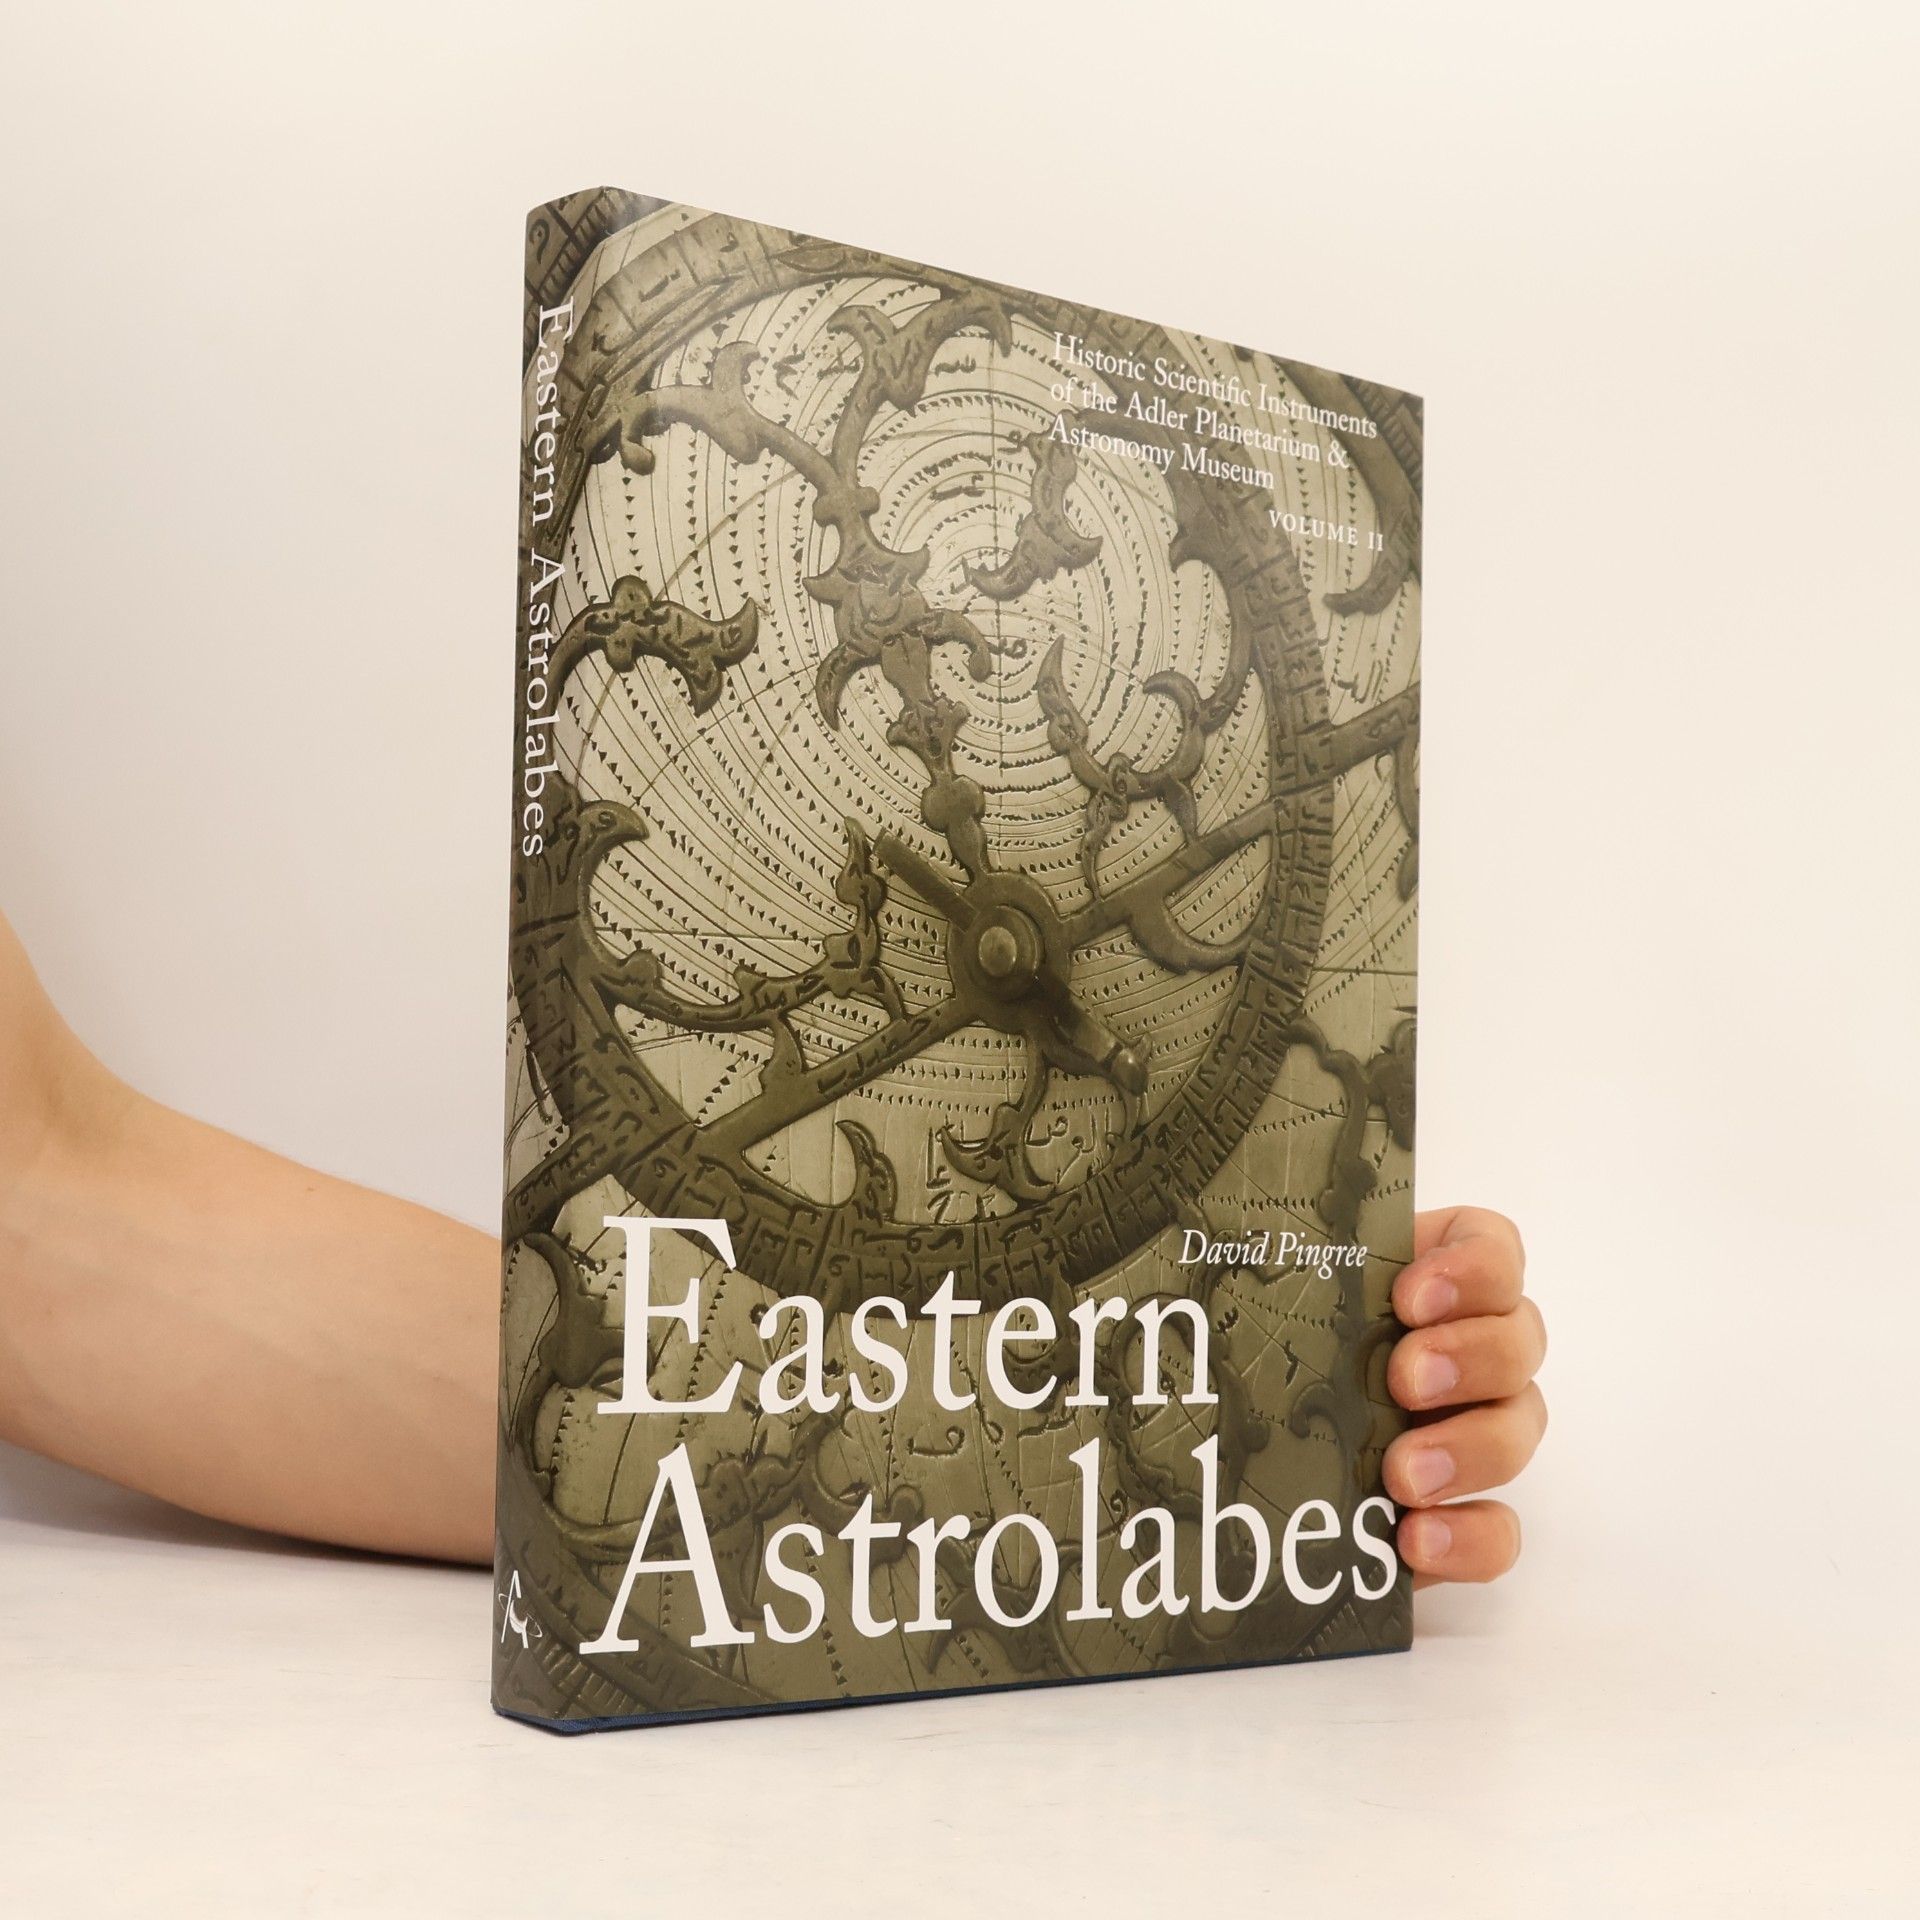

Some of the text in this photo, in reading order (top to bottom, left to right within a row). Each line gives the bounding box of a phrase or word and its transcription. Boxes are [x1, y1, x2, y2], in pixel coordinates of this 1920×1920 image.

[1051, 377, 1350, 469] of the Adler Planetarium &
[1054, 332, 1378, 439] Historic Scientific Instruments
[1048, 414, 1274, 490] Astronomy Museum
[523, 296, 574, 858] Eastern Astrolabes
[1269, 510, 1384, 551] VOLUME II
[1178, 1229, 1367, 1279] David Pingree
[597, 1215, 1219, 1415] Eastern
[579, 1434, 1398, 1655] Astrolabes
